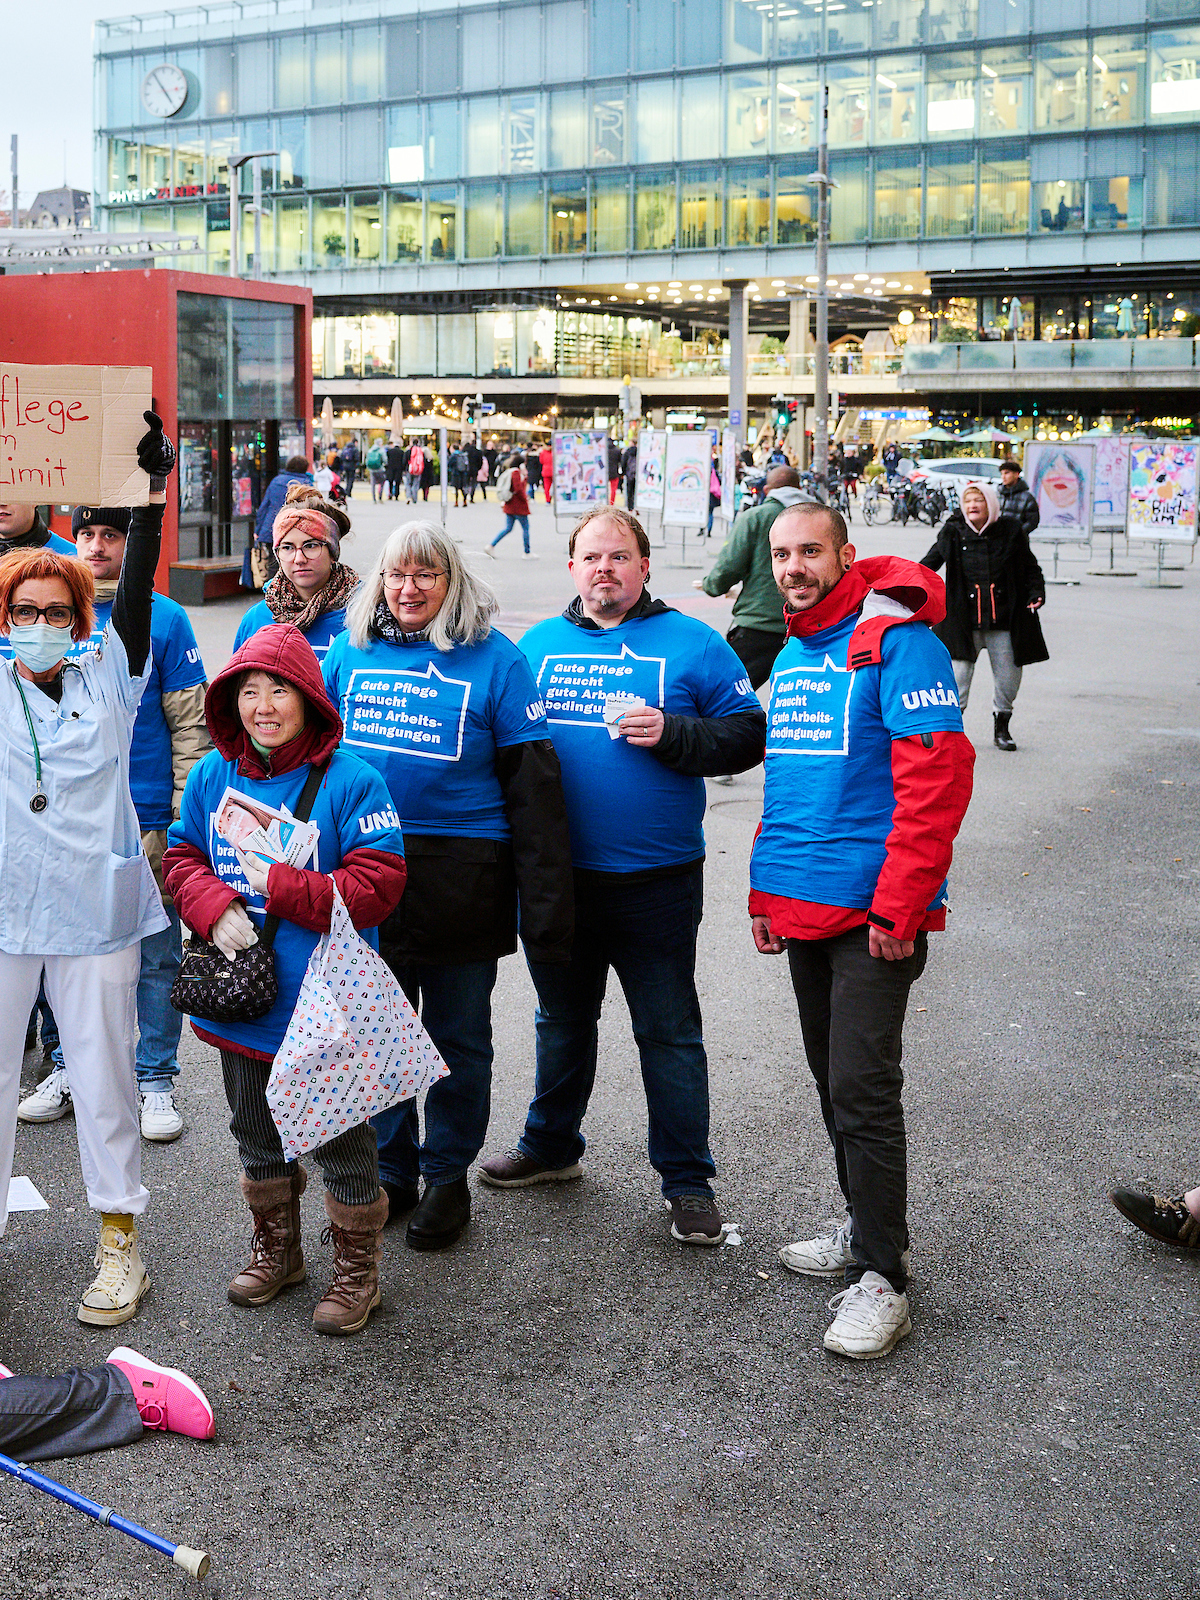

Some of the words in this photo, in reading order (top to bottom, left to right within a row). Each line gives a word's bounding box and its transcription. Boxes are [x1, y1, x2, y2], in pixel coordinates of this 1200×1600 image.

[554, 664, 585, 673] Gute
[588, 665, 633, 676] Pflege
[550, 675, 603, 687] braucht
[777, 680, 794, 693] Gute
[796, 679, 832, 694] Pflege
[360, 681, 390, 691] Gute
[393, 682, 438, 699] Pflege
[546, 688, 577, 698] gute
[581, 690, 640, 699] Arbeits-
[355, 694, 407, 708] braucht
[545, 700, 604, 715] bedingu
[775, 695, 807, 707] braucht
[354, 707, 382, 720] gute
[385, 711, 442, 728] Arbeits-
[772, 712, 789, 725] gute
[791, 711, 834, 724] Arbeits-
[352, 721, 441, 744] bedingungen
[771, 728, 832, 741] bedingungen
[218, 862, 242, 876] gute
